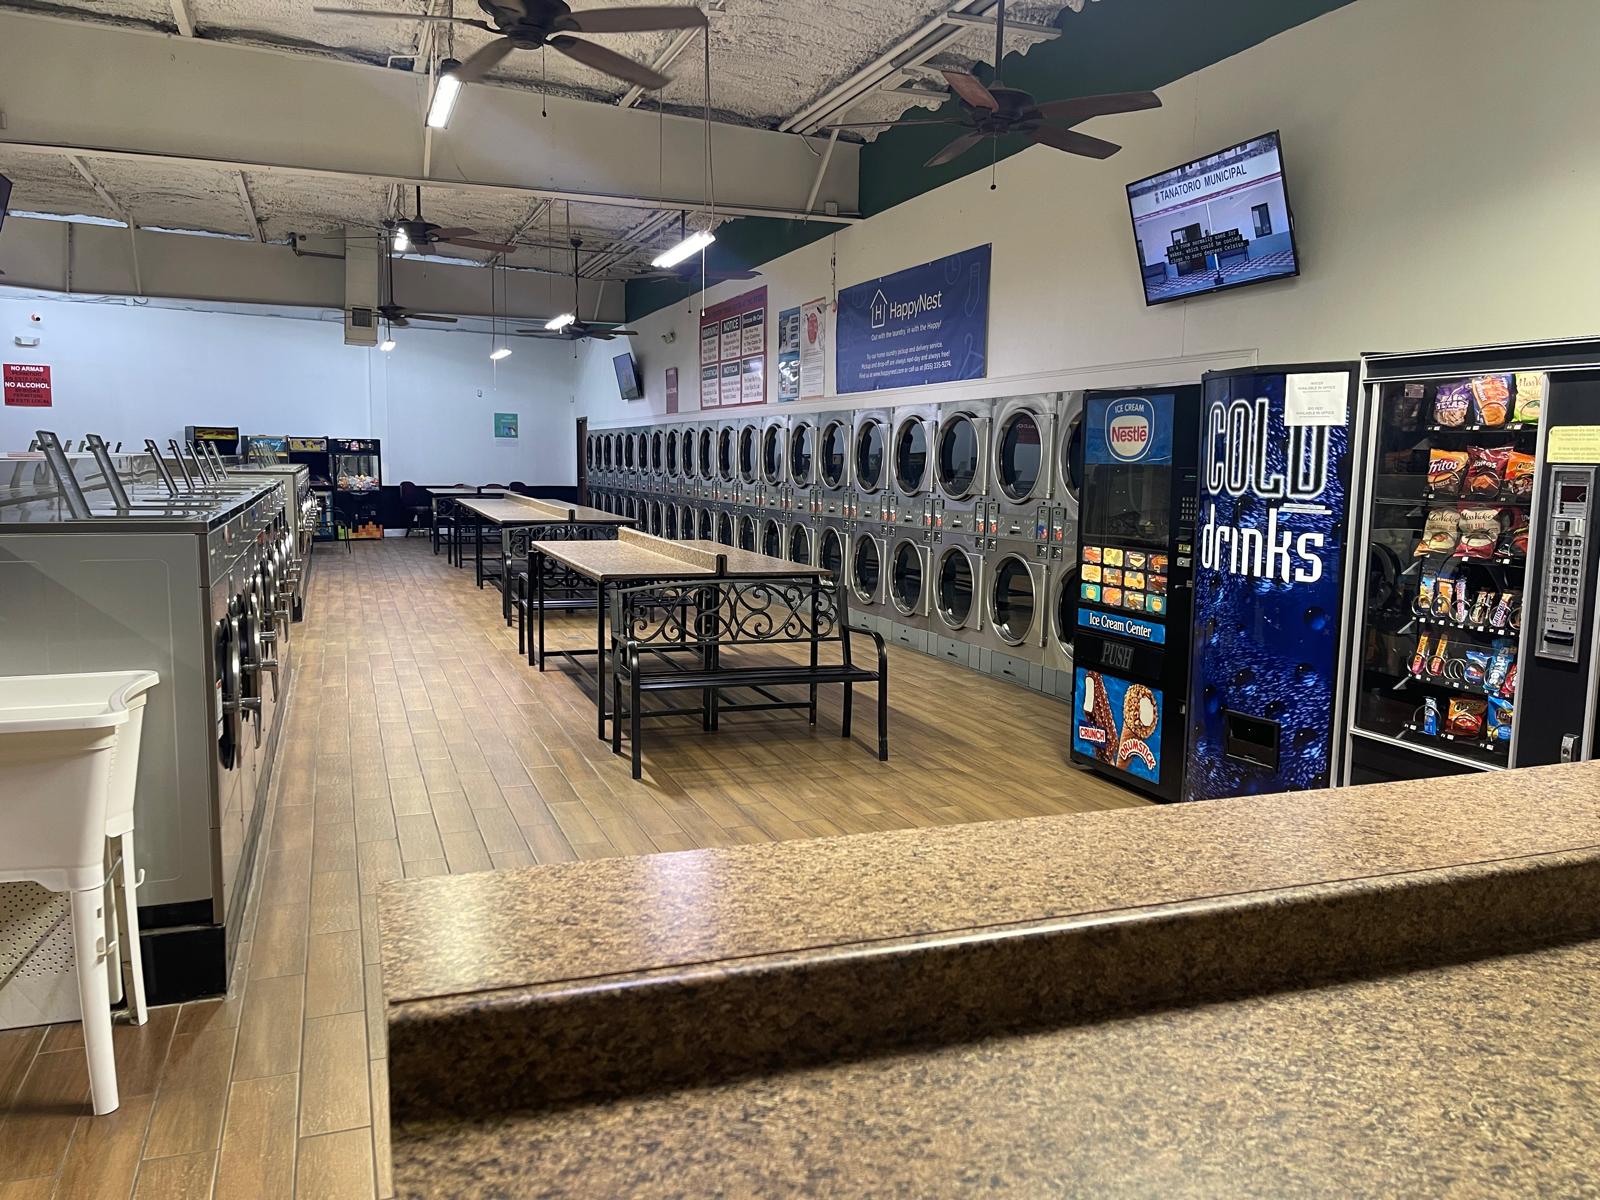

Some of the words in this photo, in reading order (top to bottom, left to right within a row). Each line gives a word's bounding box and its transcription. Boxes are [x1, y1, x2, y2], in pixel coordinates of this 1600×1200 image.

[1160, 178, 1201, 201] TANATORIO
[1204, 164, 1248, 186] MUNICIPAL
[1192, 236, 1213, 246] normally
[875, 304, 882, 320] H
[889, 290, 942, 321] HappyNest
[723, 318, 739, 332] NOTICE
[911, 325, 919, 333] with
[1115, 405, 1124, 413] ICE
[1125, 403, 1145, 412] CREAM
[1207, 398, 1330, 499] COLD
[1429, 459, 1459, 475] Fritos
[1201, 503, 1325, 583] drinks
[1089, 612, 1101, 625] Ice
[1101, 615, 1125, 632] Cream
[1126, 620, 1152, 638] Center
[1101, 642, 1133, 669] PUSH
[1080, 728, 1105, 740] CRUNCH
[1119, 739, 1156, 770] DRUMSTICK
